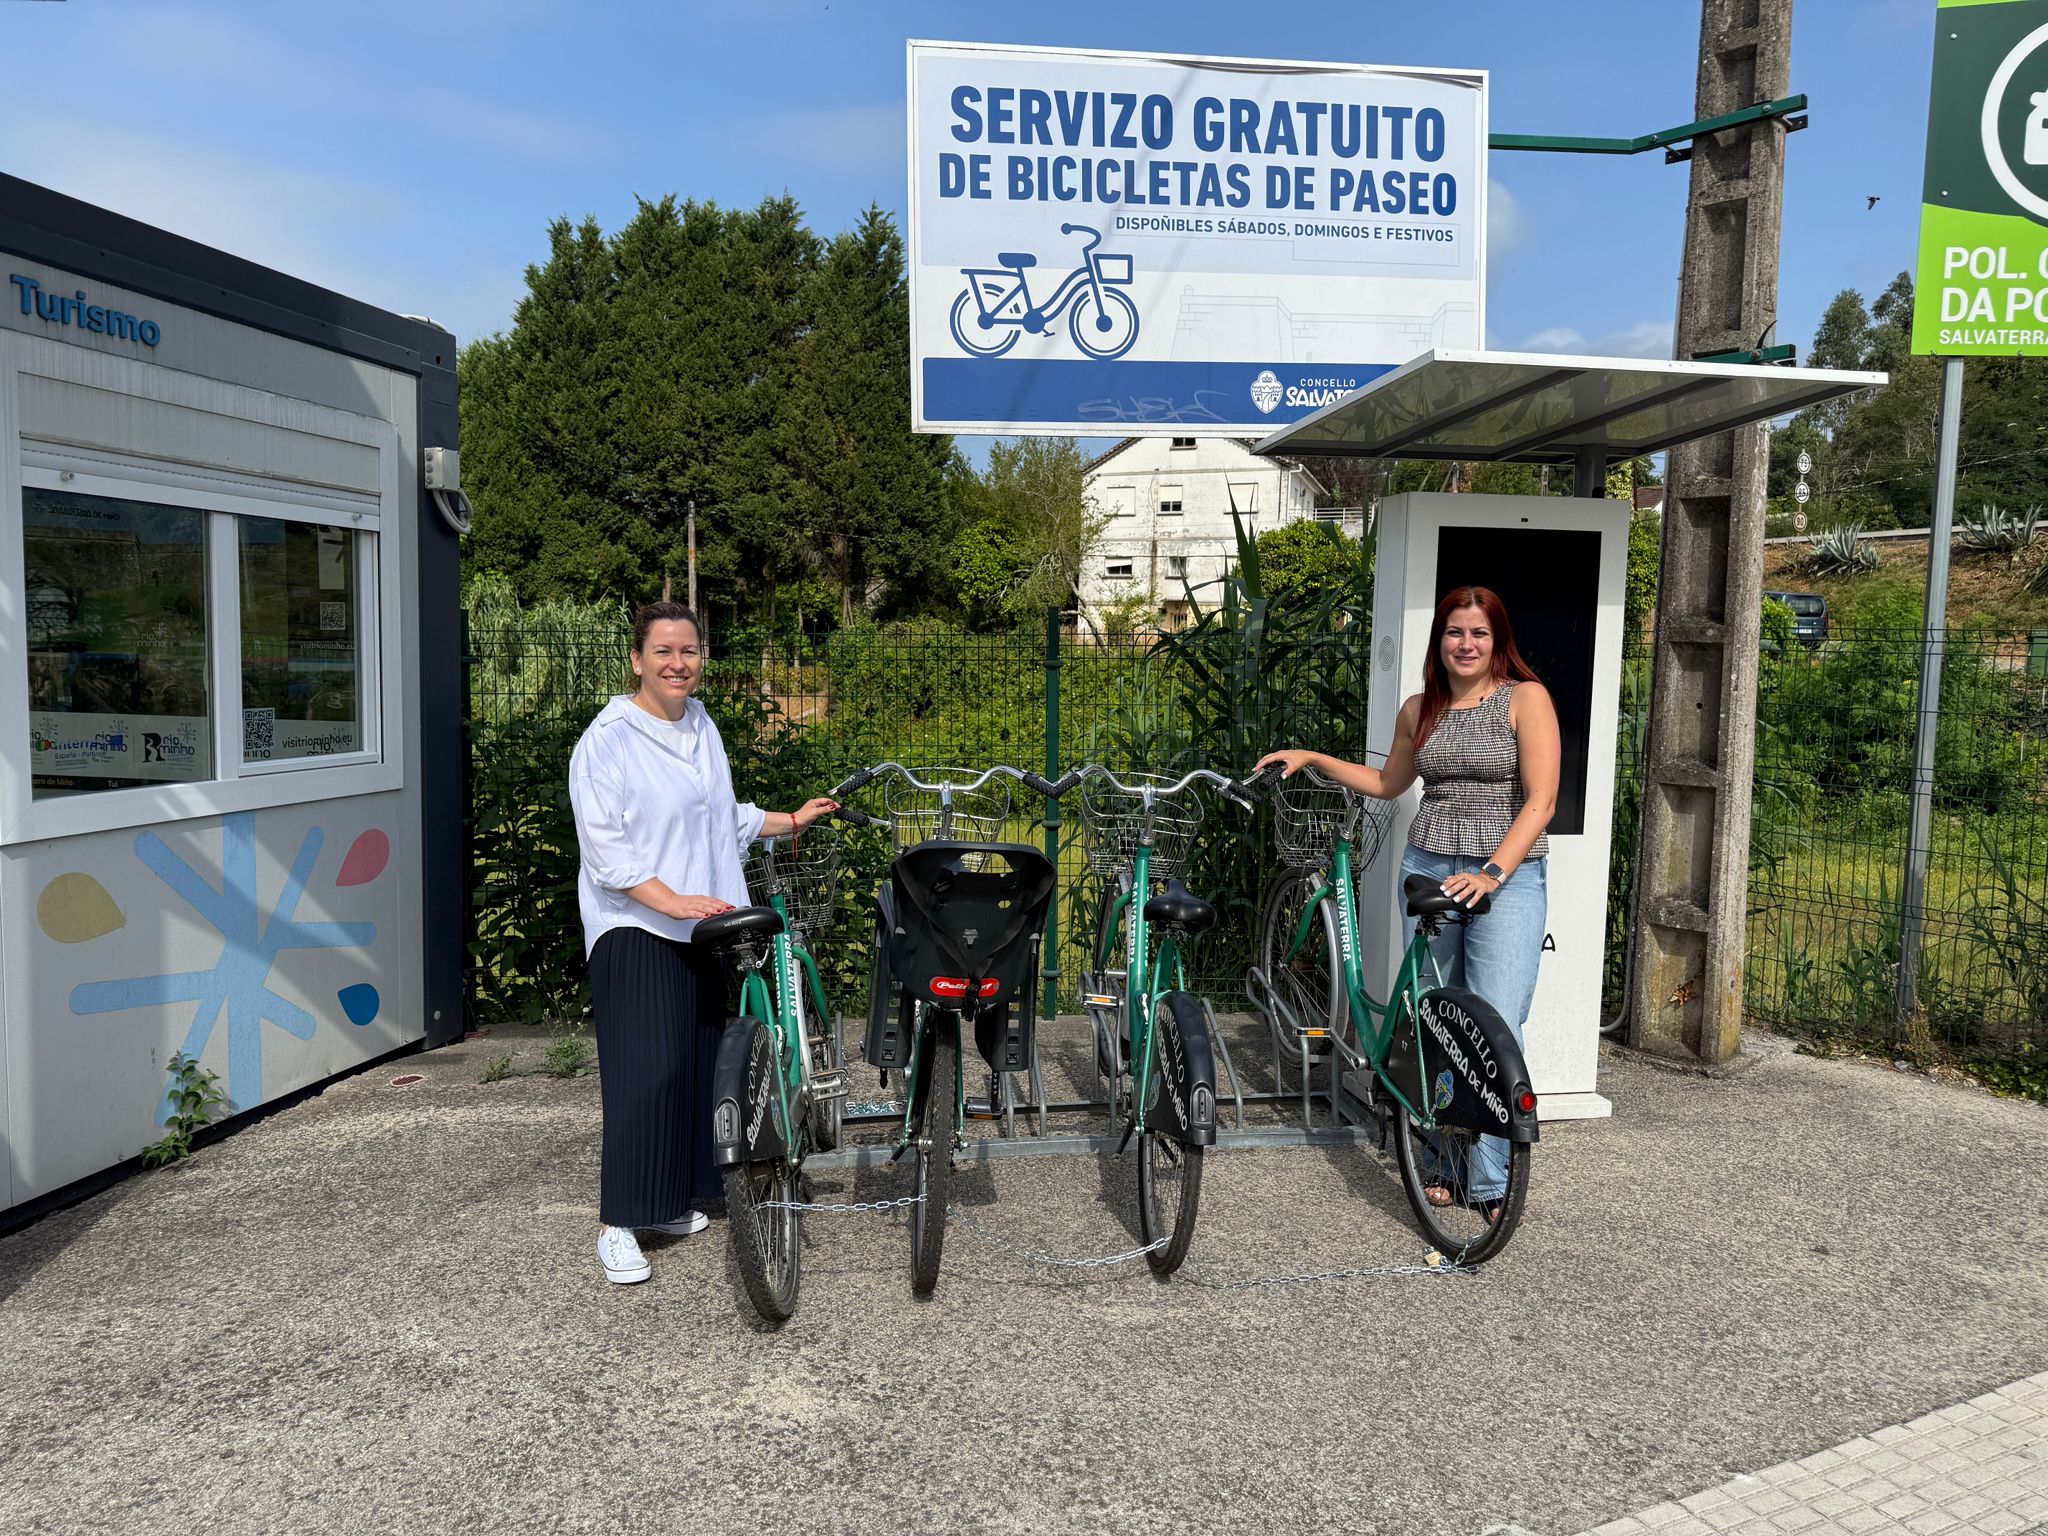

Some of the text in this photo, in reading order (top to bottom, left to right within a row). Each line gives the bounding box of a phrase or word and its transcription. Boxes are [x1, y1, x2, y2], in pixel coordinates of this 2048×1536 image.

[950, 85, 1445, 162] SERVIZO GRATUITO
[939, 152, 1456, 216] DE BICICLETAS DE PASEO
[1116, 215, 1453, 242] DISPOÑIBLES SÁBADOS, DOMINGOS E FESTIVOS
[1943, 246, 2028, 279] POL.
[10, 274, 160, 346] Turismo
[1941, 287, 1996, 322] DA
[1300, 378, 1356, 387] CONCELLO
[1336, 878, 1352, 962] SALVATERRA
[1419, 998, 1469, 1077] SALVATERRA
[1438, 1000, 1498, 1079] CONCELLO
